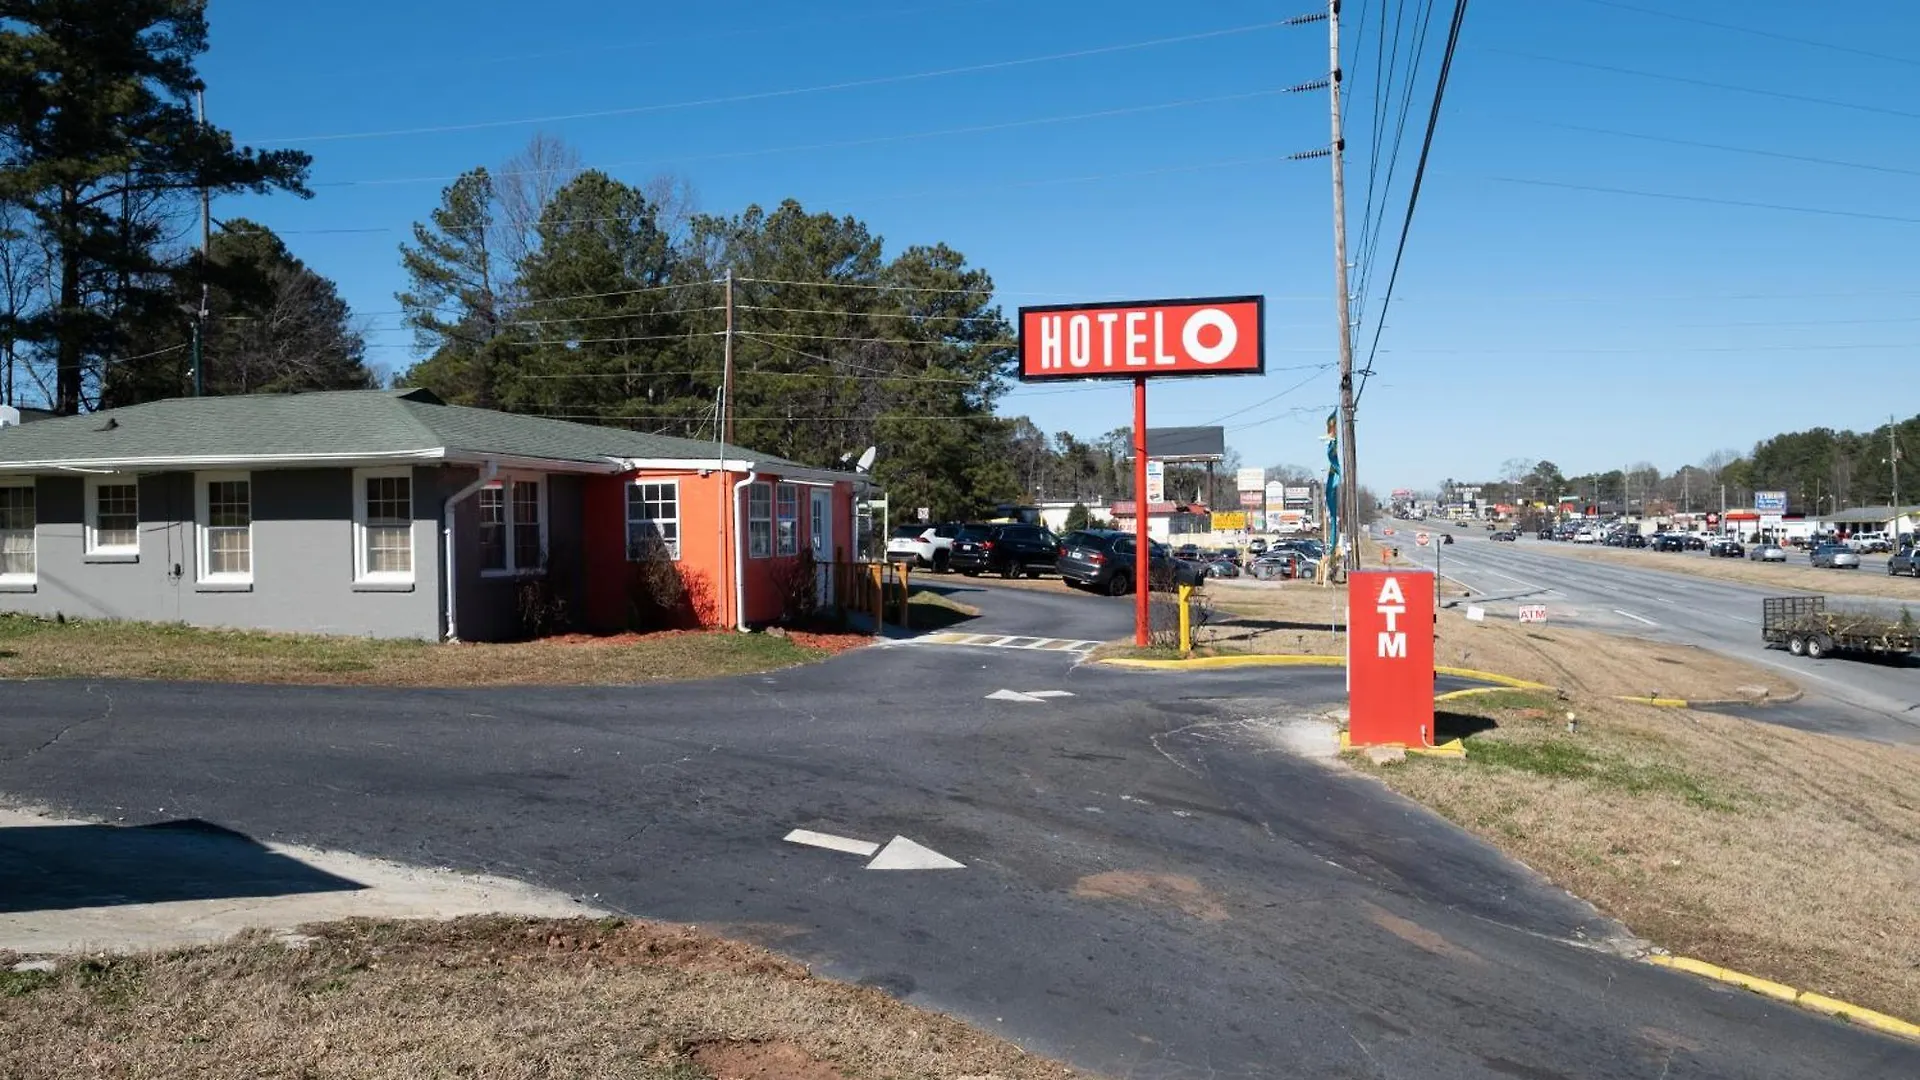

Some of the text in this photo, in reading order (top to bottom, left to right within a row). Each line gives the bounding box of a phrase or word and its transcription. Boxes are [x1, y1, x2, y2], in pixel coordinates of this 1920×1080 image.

[1041, 308, 1238, 369] HOTEL O
[1377, 577, 1407, 658] ATM
[1520, 609, 1546, 620] ATM
